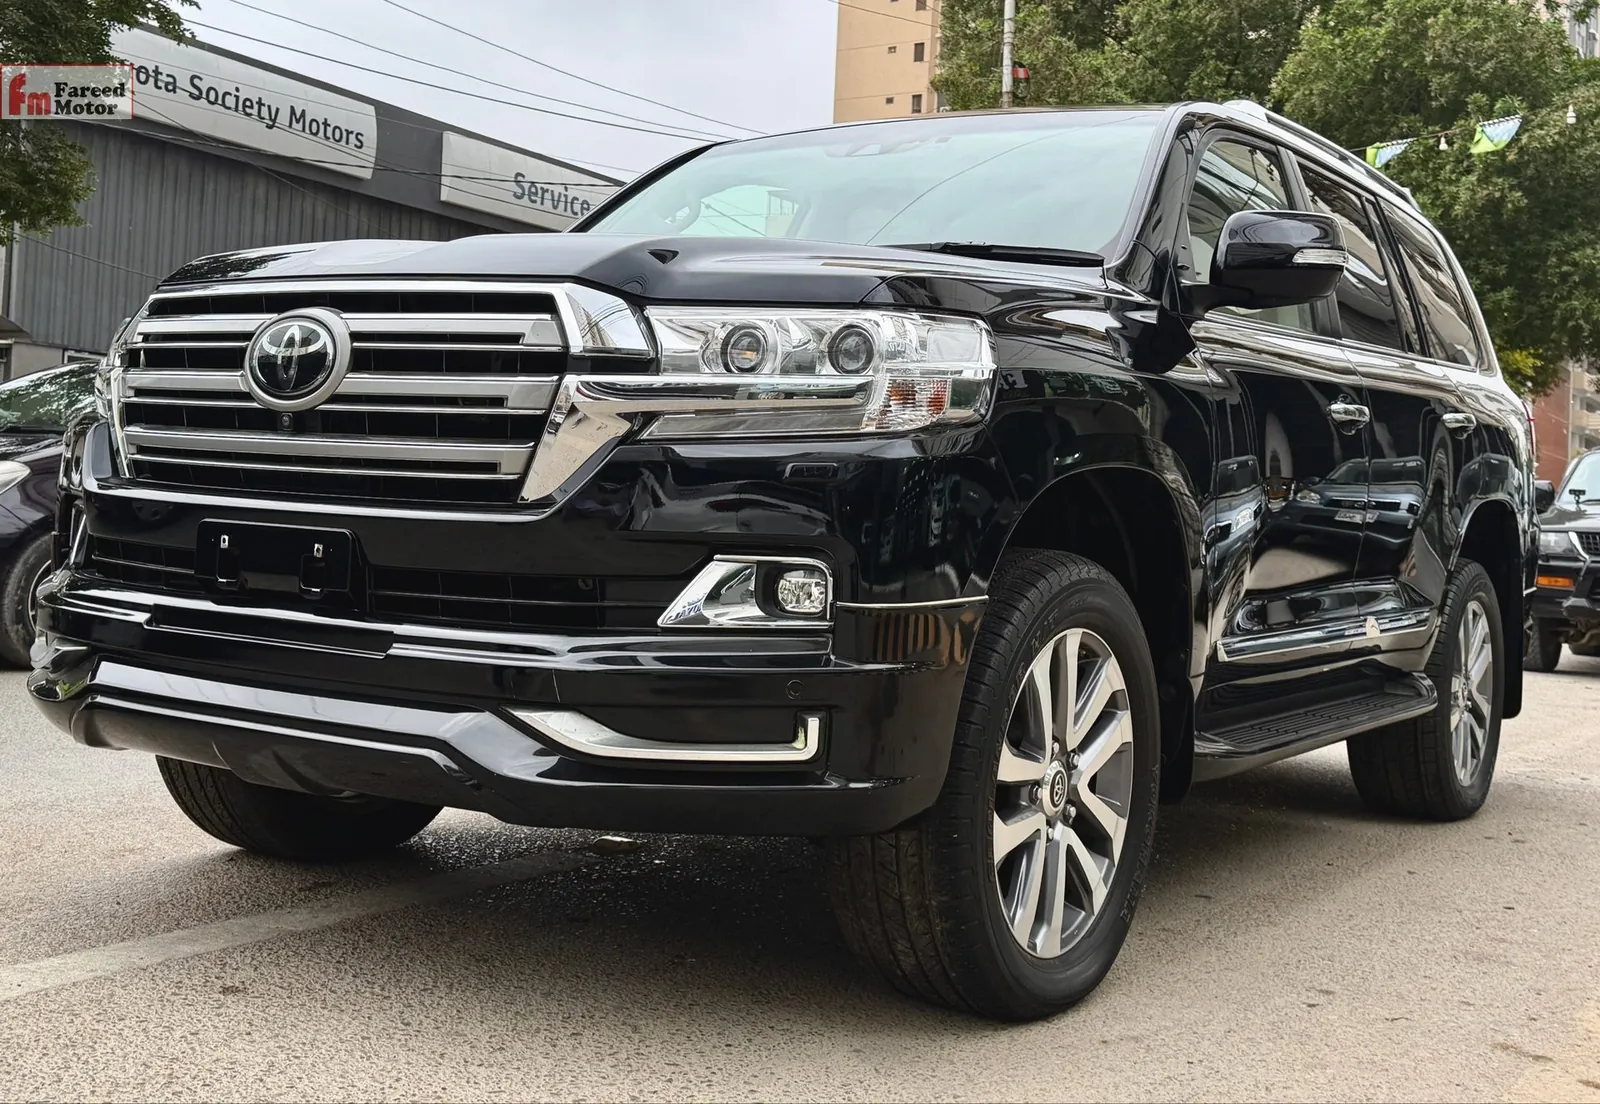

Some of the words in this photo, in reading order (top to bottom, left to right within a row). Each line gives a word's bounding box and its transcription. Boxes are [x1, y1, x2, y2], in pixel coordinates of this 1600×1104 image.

[136, 65, 177, 94] ota
[189, 74, 280, 129] Society
[288, 105, 364, 150] Motors
[513, 172, 591, 216] Service
